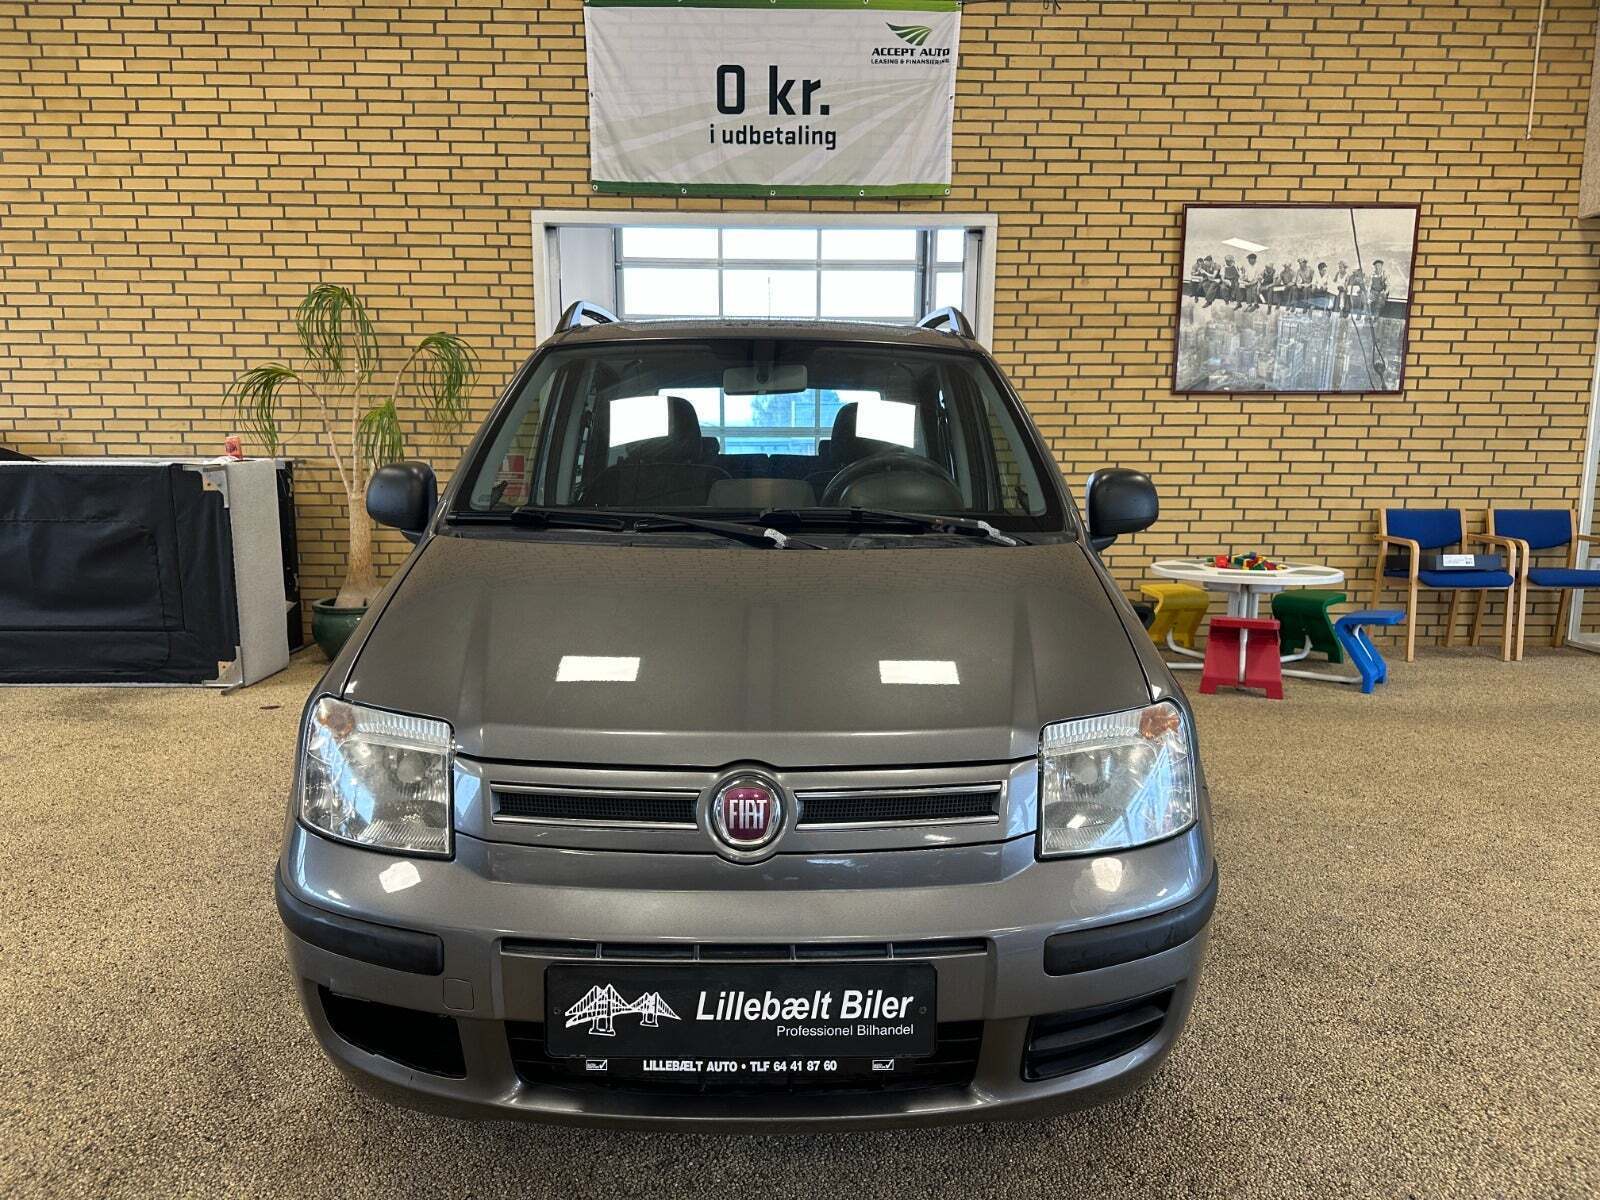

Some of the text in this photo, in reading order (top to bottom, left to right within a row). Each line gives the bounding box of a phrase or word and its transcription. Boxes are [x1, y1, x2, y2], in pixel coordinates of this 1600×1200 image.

[872, 48, 916, 56] ACCEPT
[769, 65, 830, 115] kr.
[710, 123, 837, 151] i udbetaling
[729, 794, 768, 830] FIAT
[696, 990, 914, 1021] Lillebælt Biler
[776, 1024, 914, 1037] Professionel Bilhandel
[643, 1060, 838, 1072] LILLEBÆLT AUTO TLF 64 41 87 60
